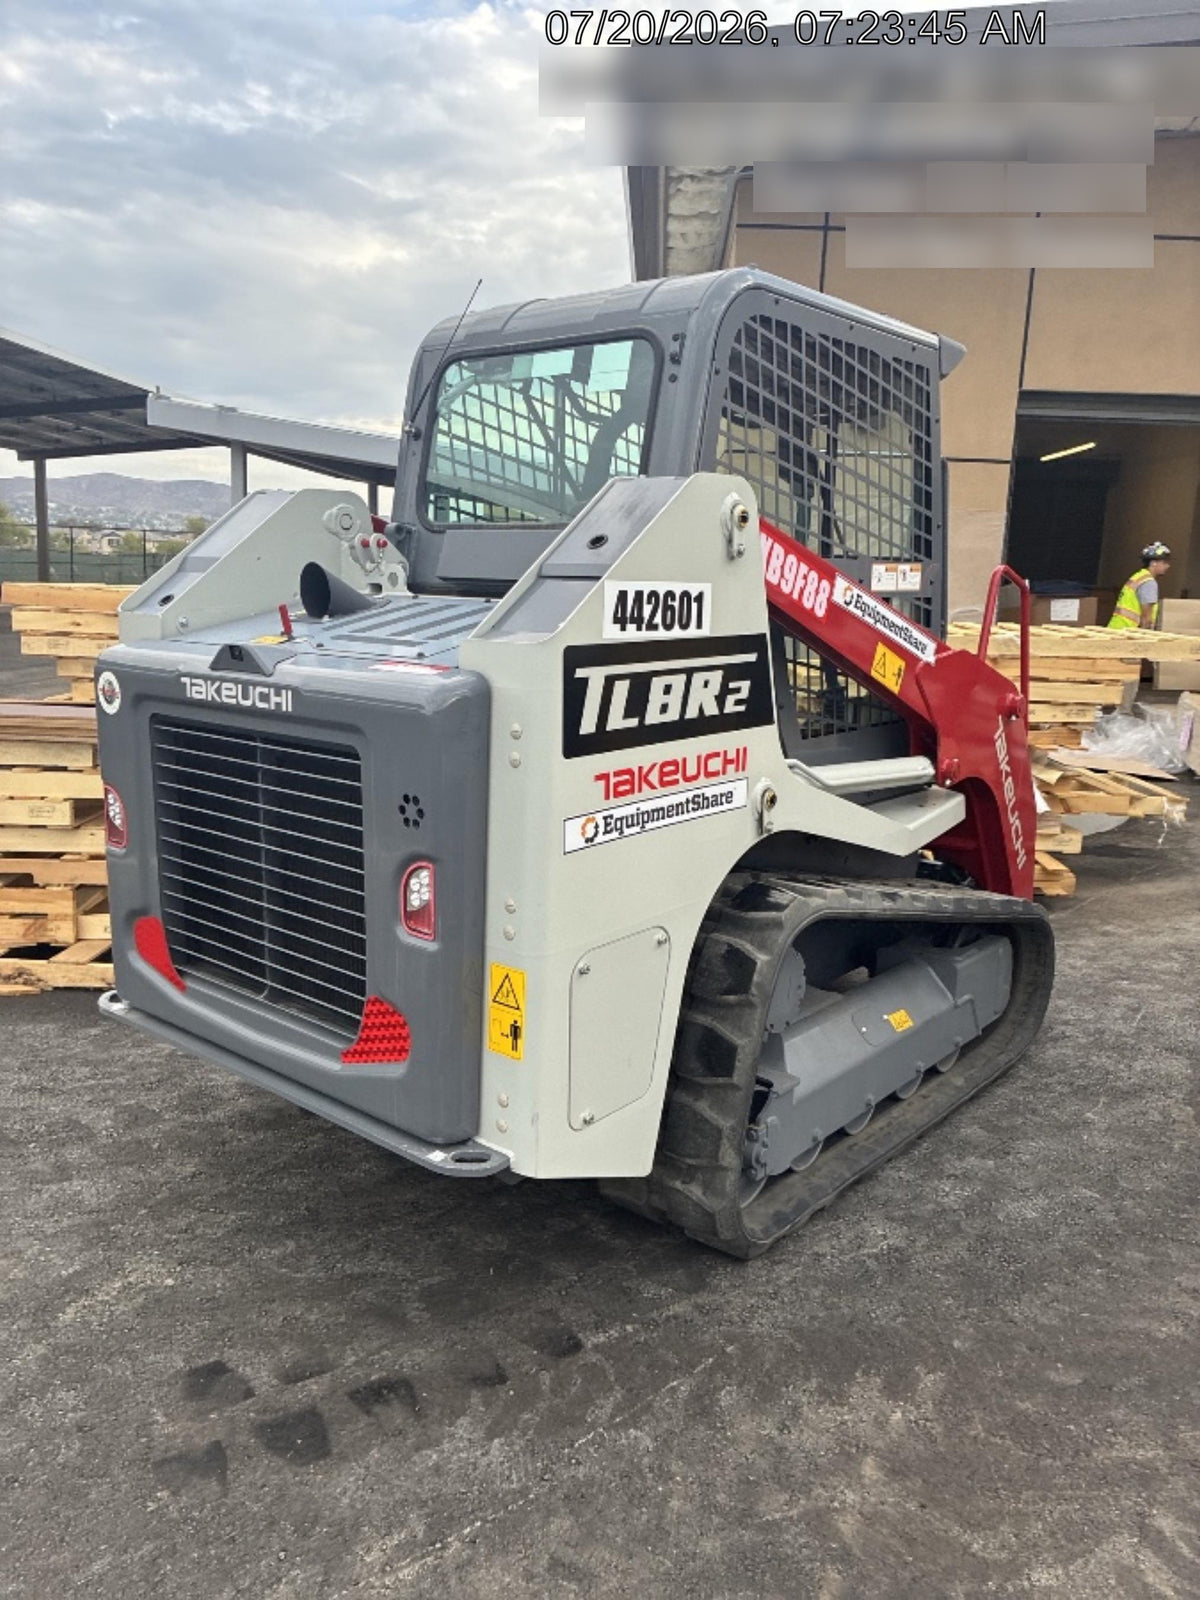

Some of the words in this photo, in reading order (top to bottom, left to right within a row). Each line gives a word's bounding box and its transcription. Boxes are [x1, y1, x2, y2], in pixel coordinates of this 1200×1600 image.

[612, 589, 705, 632] 442601
[854, 593, 928, 655] EquipmentShare
[180, 676, 293, 712] TAKEUCHI
[574, 652, 758, 736] TL8R2
[594, 746, 748, 801] TAKEUCHI
[602, 788, 734, 836] EquipmentShare
